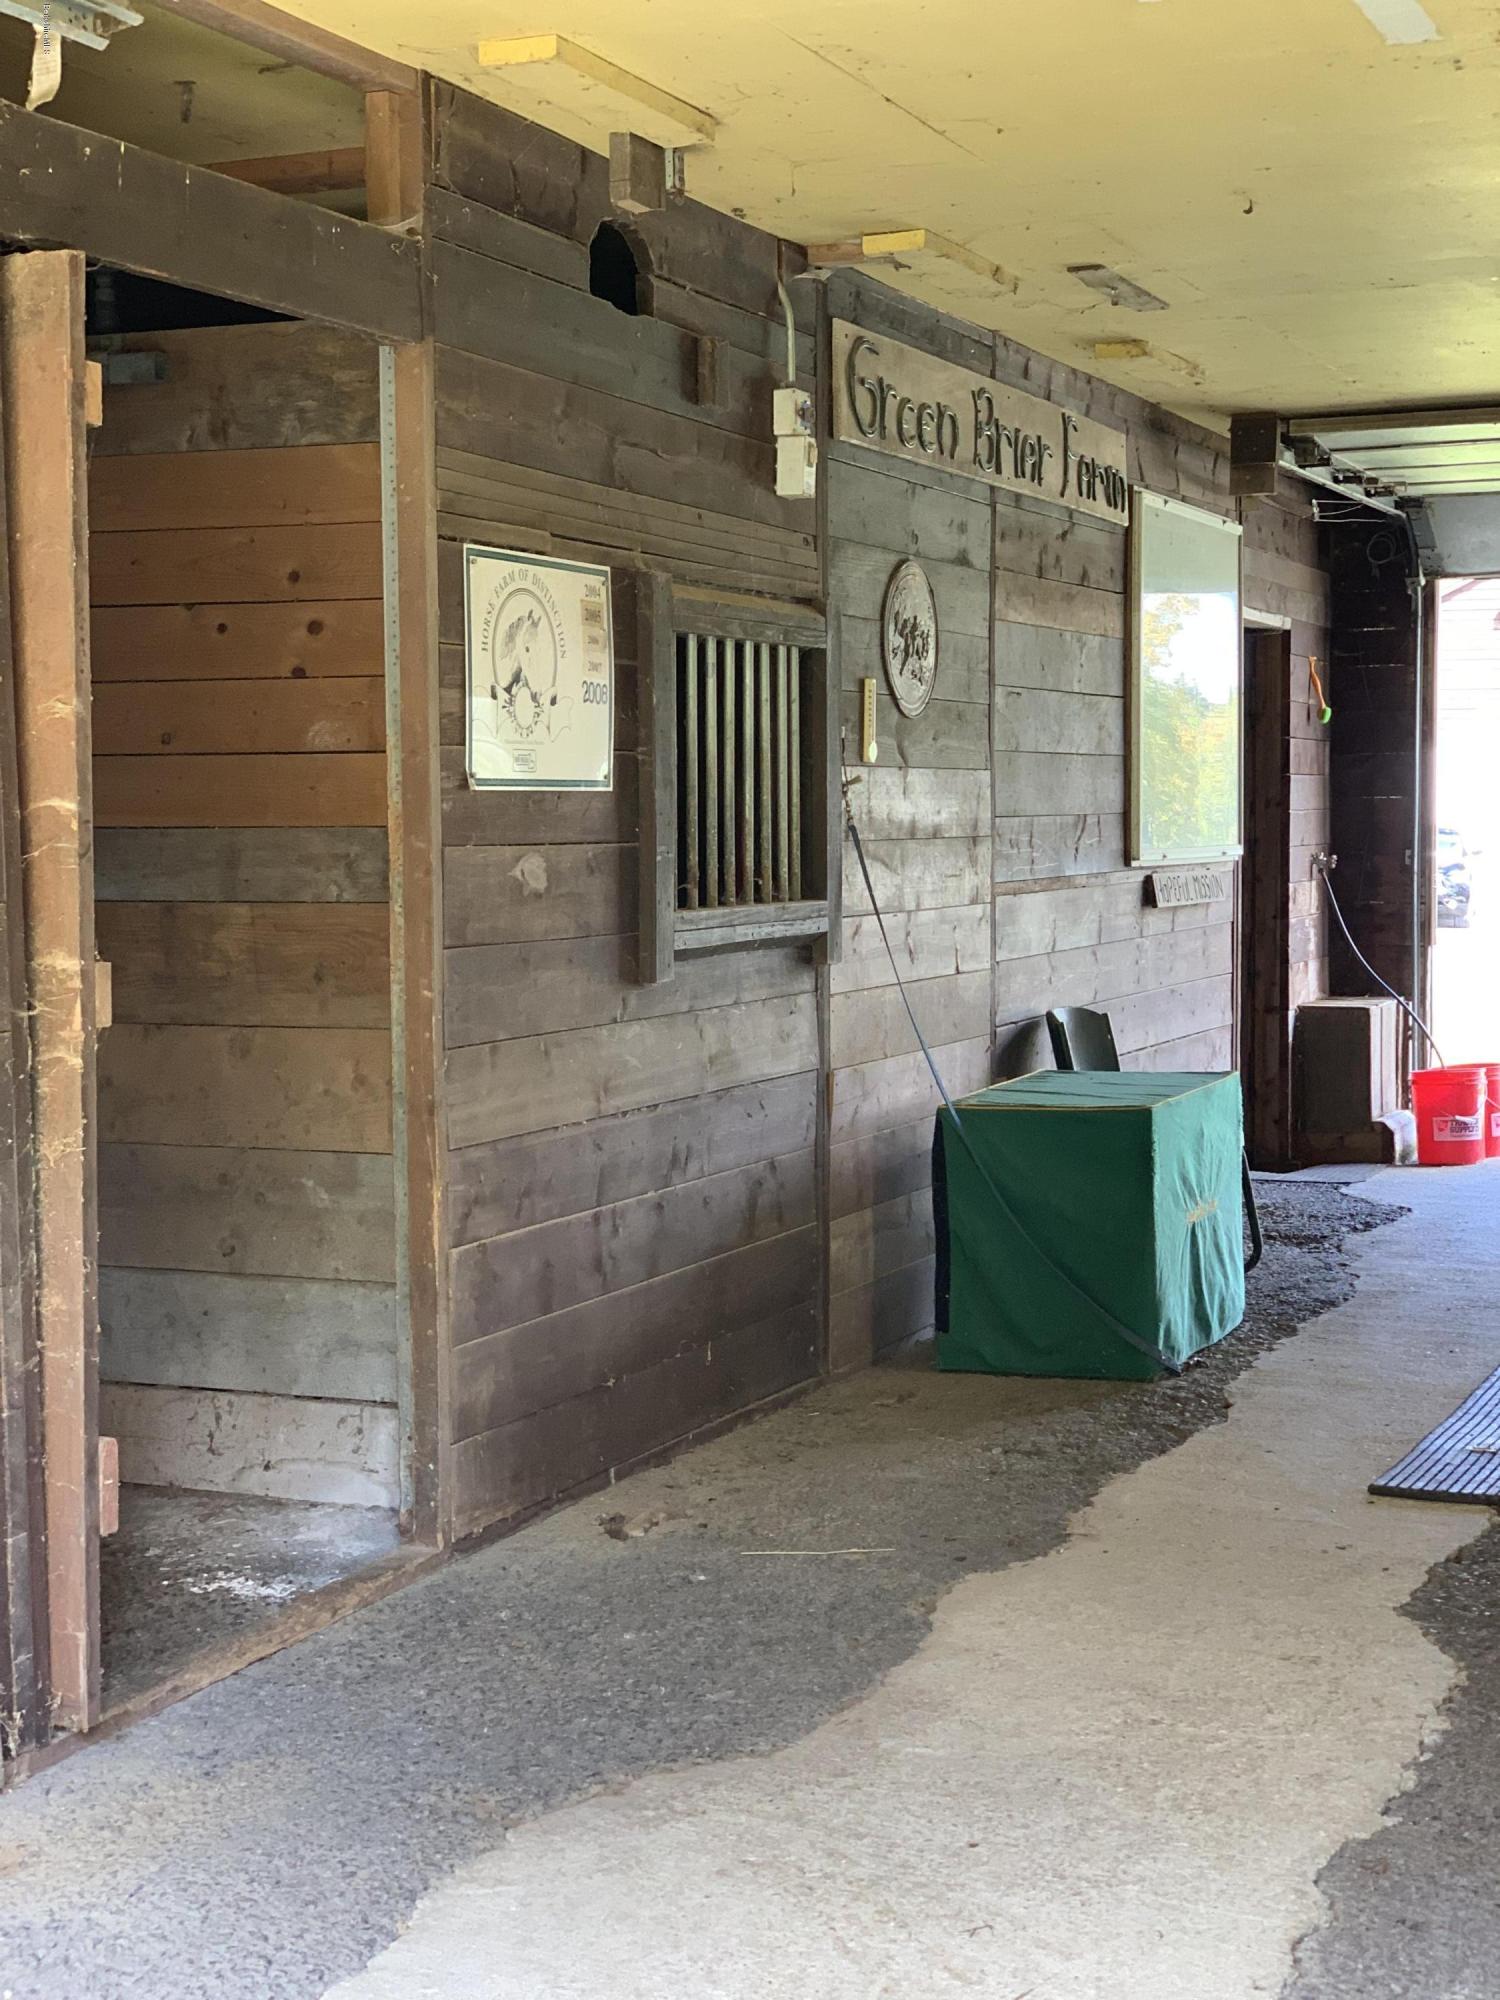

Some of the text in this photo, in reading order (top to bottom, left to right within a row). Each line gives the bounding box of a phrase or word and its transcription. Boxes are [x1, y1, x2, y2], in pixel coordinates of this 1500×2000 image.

[846, 336, 959, 459] Green
[1060, 412, 1126, 513] Farm
[584, 584, 601, 598] 2004
[481, 568, 567, 658] HORSE FARM OF DISTINCTION
[581, 681, 608, 705] 2008
[1450, 1118, 1479, 1126] TRACR
